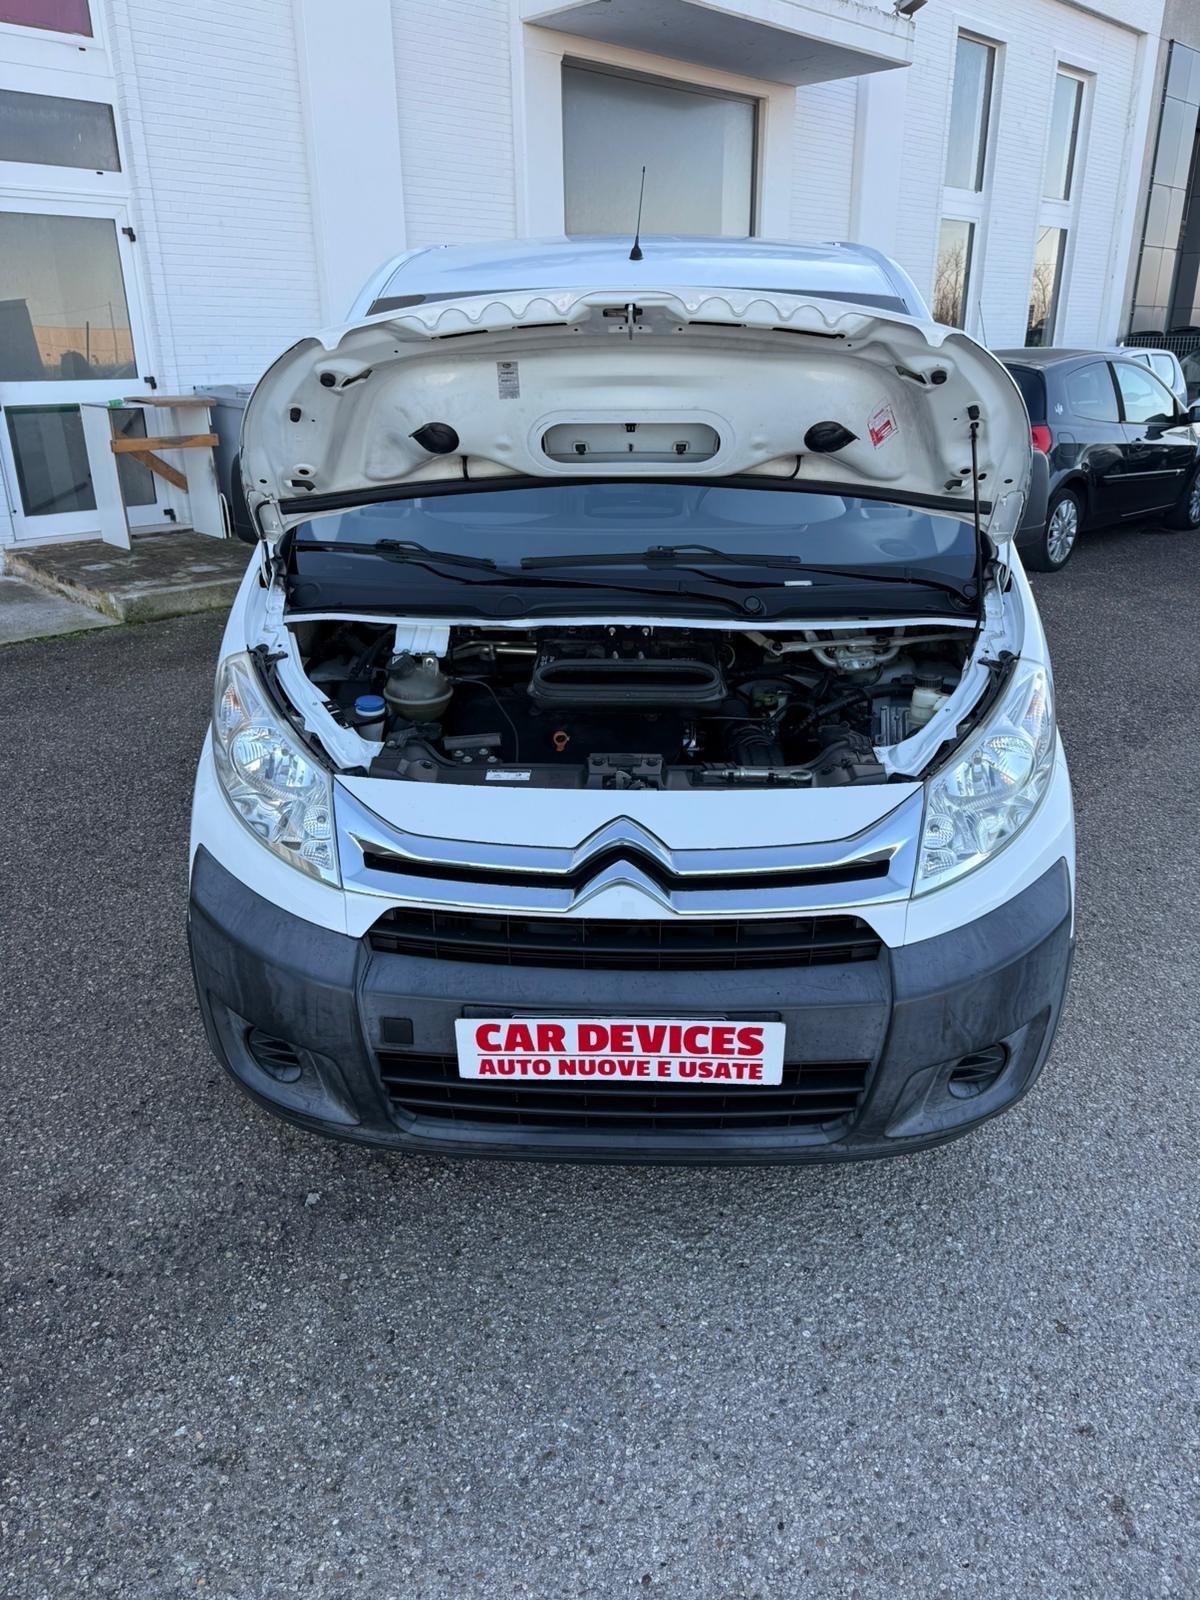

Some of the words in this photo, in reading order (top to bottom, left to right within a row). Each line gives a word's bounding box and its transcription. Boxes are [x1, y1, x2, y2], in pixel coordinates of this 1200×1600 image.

[475, 1023, 566, 1054] CAR
[577, 1023, 764, 1056] DEVICES
[479, 1058, 552, 1076] AUTO
[558, 1059, 650, 1077] NUOVE
[657, 1060, 671, 1077] E
[678, 1061, 763, 1081] USATE
